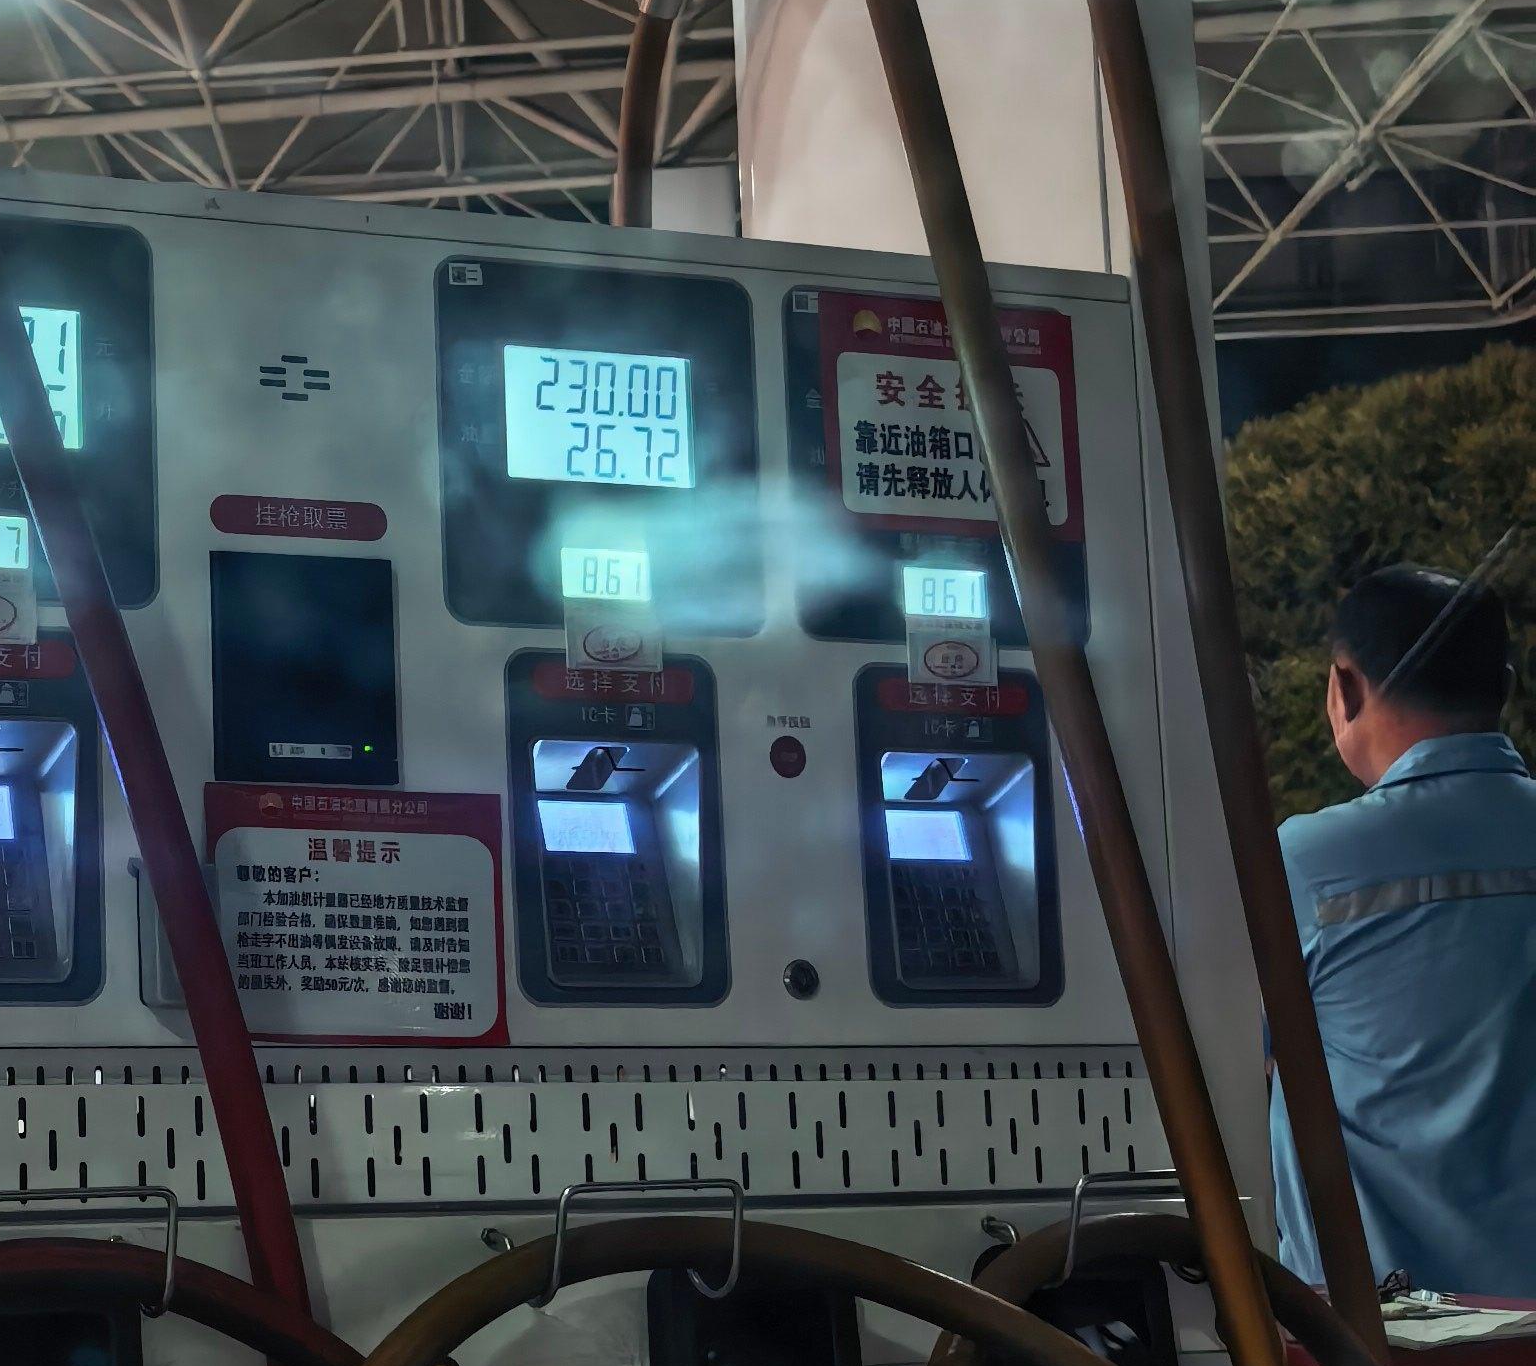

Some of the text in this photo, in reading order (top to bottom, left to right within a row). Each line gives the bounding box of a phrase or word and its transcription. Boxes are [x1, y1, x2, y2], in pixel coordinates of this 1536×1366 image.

[537, 356, 678, 419] 230.00
[876, 370, 1025, 413] 安全
[567, 422, 680, 482] 26.72
[854, 419, 984, 462] 靠近油箱口
[256, 500, 348, 530] 挂枪取票
[582, 555, 641, 595] 8.61
[921, 576, 977, 614] 8.61
[308, 837, 401, 864] 温馨提示
